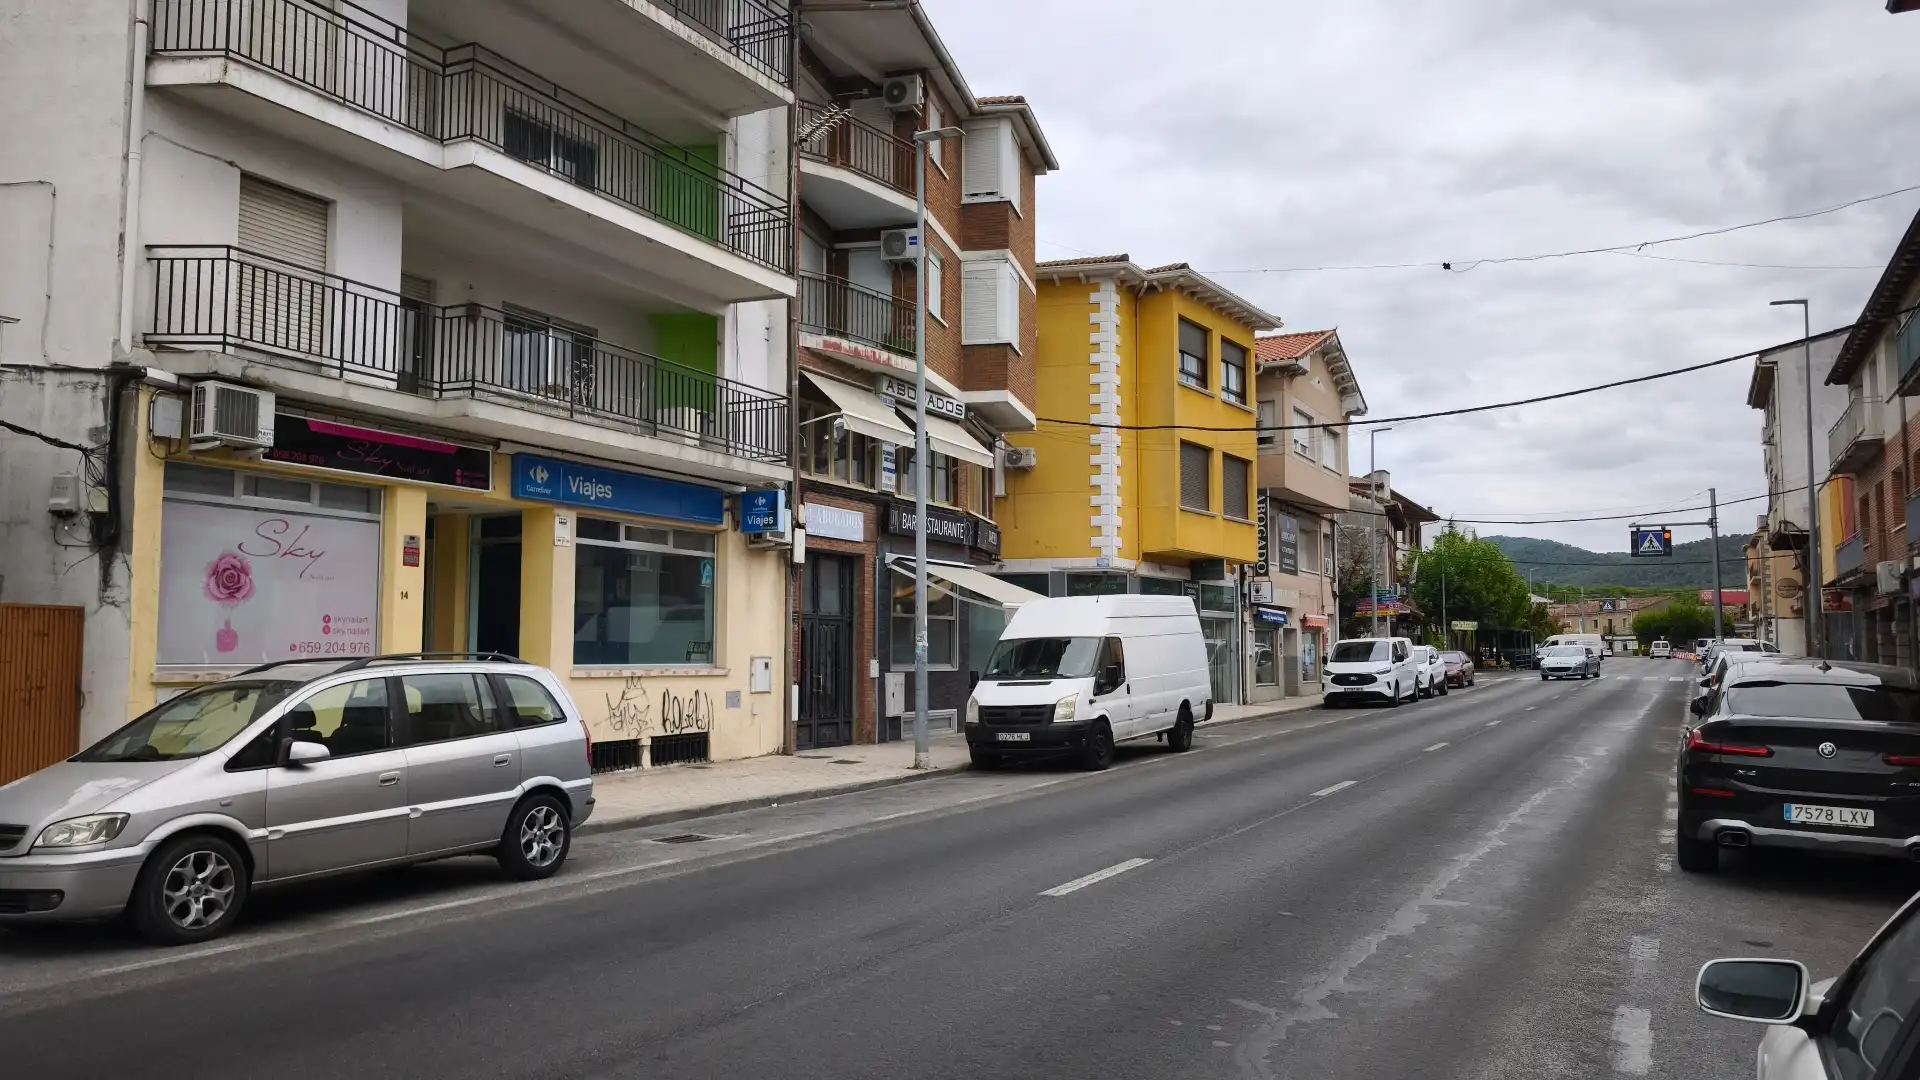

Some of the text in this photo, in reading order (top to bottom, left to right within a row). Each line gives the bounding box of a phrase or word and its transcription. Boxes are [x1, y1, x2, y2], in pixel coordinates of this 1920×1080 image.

[886, 379, 964, 417] ABOADOS
[336, 440, 393, 473] Sky
[526, 475, 613, 500] Carrefour Viajes
[746, 515, 774, 527] Viajes
[902, 512, 917, 533] BAR
[237, 518, 325, 579] Sky
[400, 591, 408, 600] 14
[299, 642, 370, 654] 659 204 976
[1794, 806, 1869, 824] 7578 LXV
